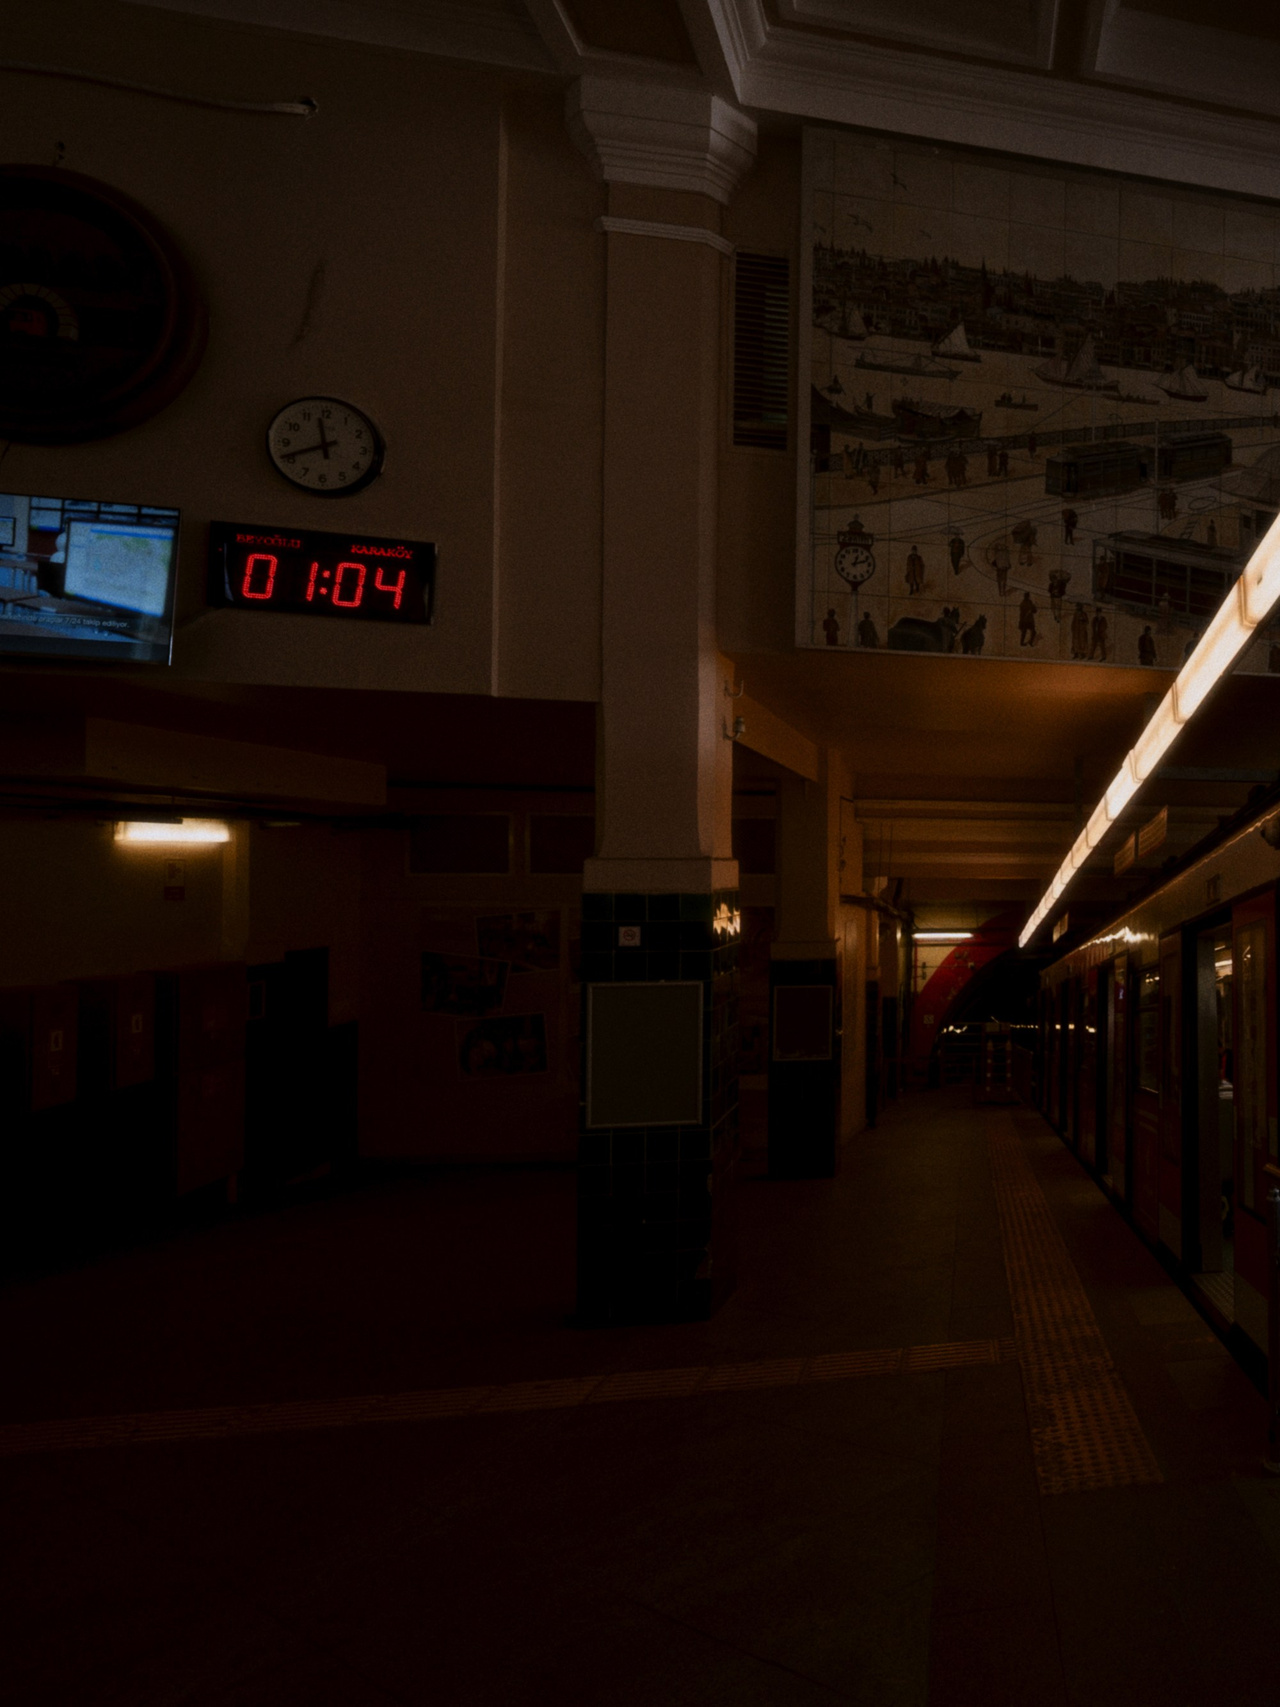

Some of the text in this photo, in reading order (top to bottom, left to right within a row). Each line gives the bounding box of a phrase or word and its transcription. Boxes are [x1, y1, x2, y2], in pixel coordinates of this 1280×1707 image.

[303, 412, 311, 421] 11
[321, 410, 332, 419] 12
[288, 422, 300, 431] 10
[355, 429, 363, 439] 2
[281, 437, 291, 447] 9
[359, 446, 367, 455] 3
[352, 461, 360, 470] 4
[301, 467, 309, 477] 7
[338, 471, 346, 481] 5
[318, 474, 327, 483] 6
[236, 533, 414, 559] BEYOĞLU KARAKÖY
[64, 617, 82, 625] 7/24
[83, 618, 101, 628] takip
